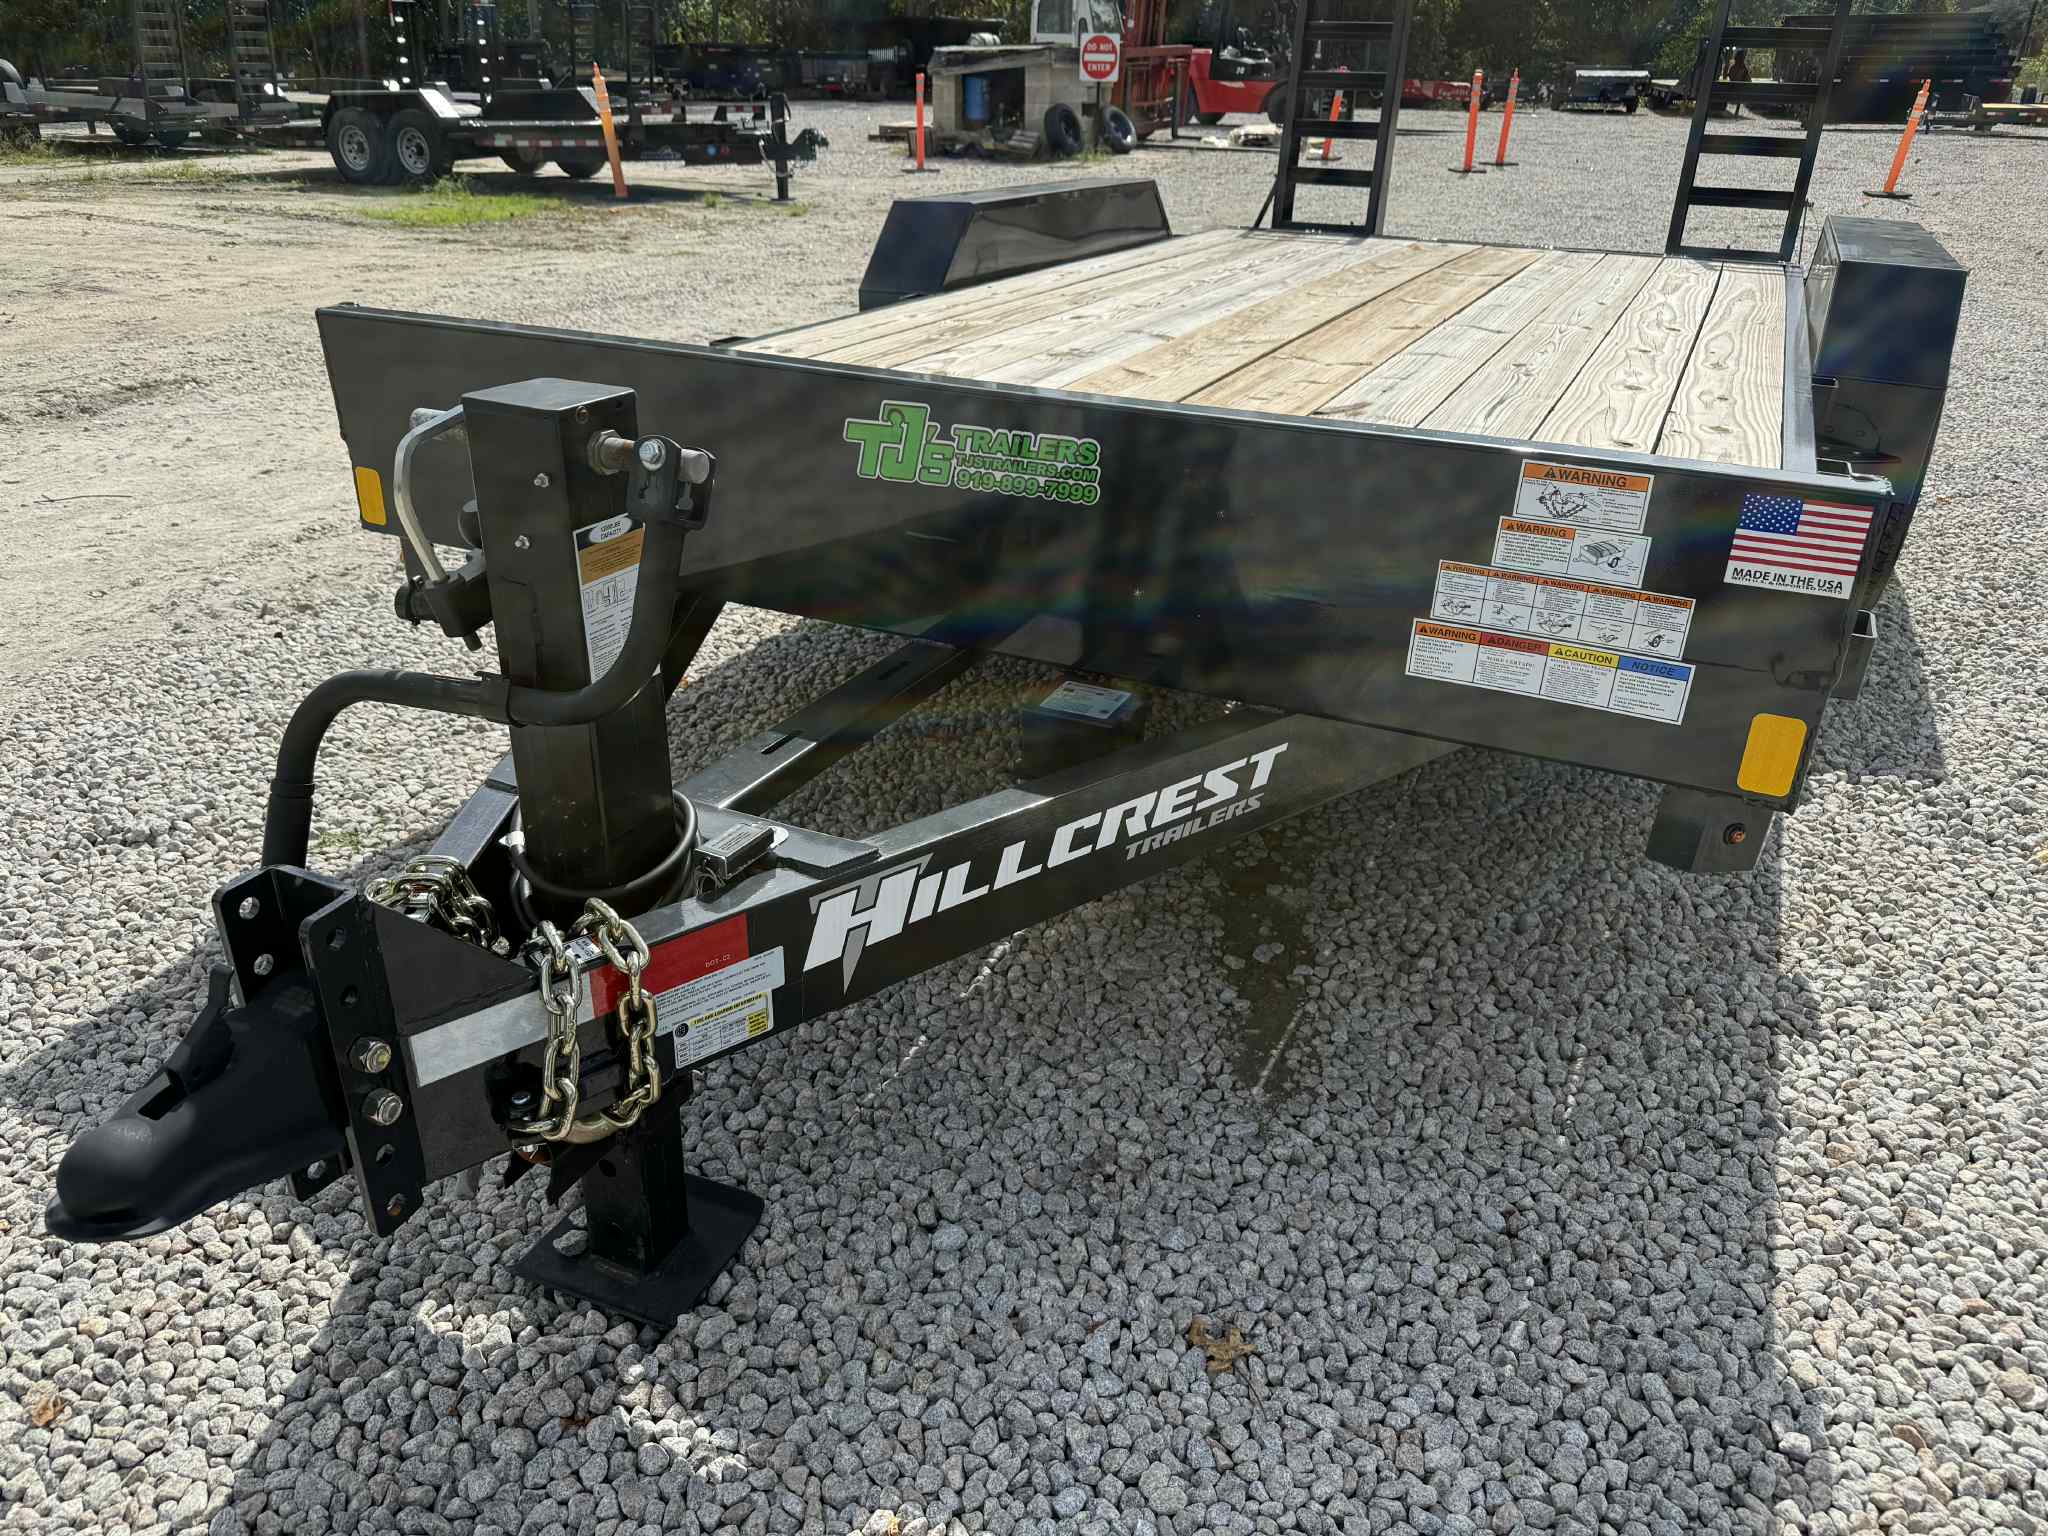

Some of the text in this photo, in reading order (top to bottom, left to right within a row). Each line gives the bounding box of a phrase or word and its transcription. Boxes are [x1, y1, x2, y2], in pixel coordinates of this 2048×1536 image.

[1087, 42, 1113, 52] DO NOT
[1087, 63, 1111, 73] ENTER
[953, 426, 1098, 466] TRAILERS
[955, 452, 1098, 483] TJSTRAILERS.COM
[956, 468, 1098, 504] 919-899-7999
[1558, 468, 1628, 488] WARNING
[1515, 522, 1567, 538] WARNING
[1452, 564, 1486, 576] WARNING
[1503, 571, 1535, 583] WARNING
[1549, 578, 1585, 591] WARNING
[1731, 566, 1843, 592] MADE IN THE USA
[1601, 587, 1637, 600] WARNING
[1653, 595, 1689, 608] WARNING
[1427, 626, 1676, 676] WARNING DANGER CAUTION NOTICE
[1124, 792, 1265, 861] TRAILERS
